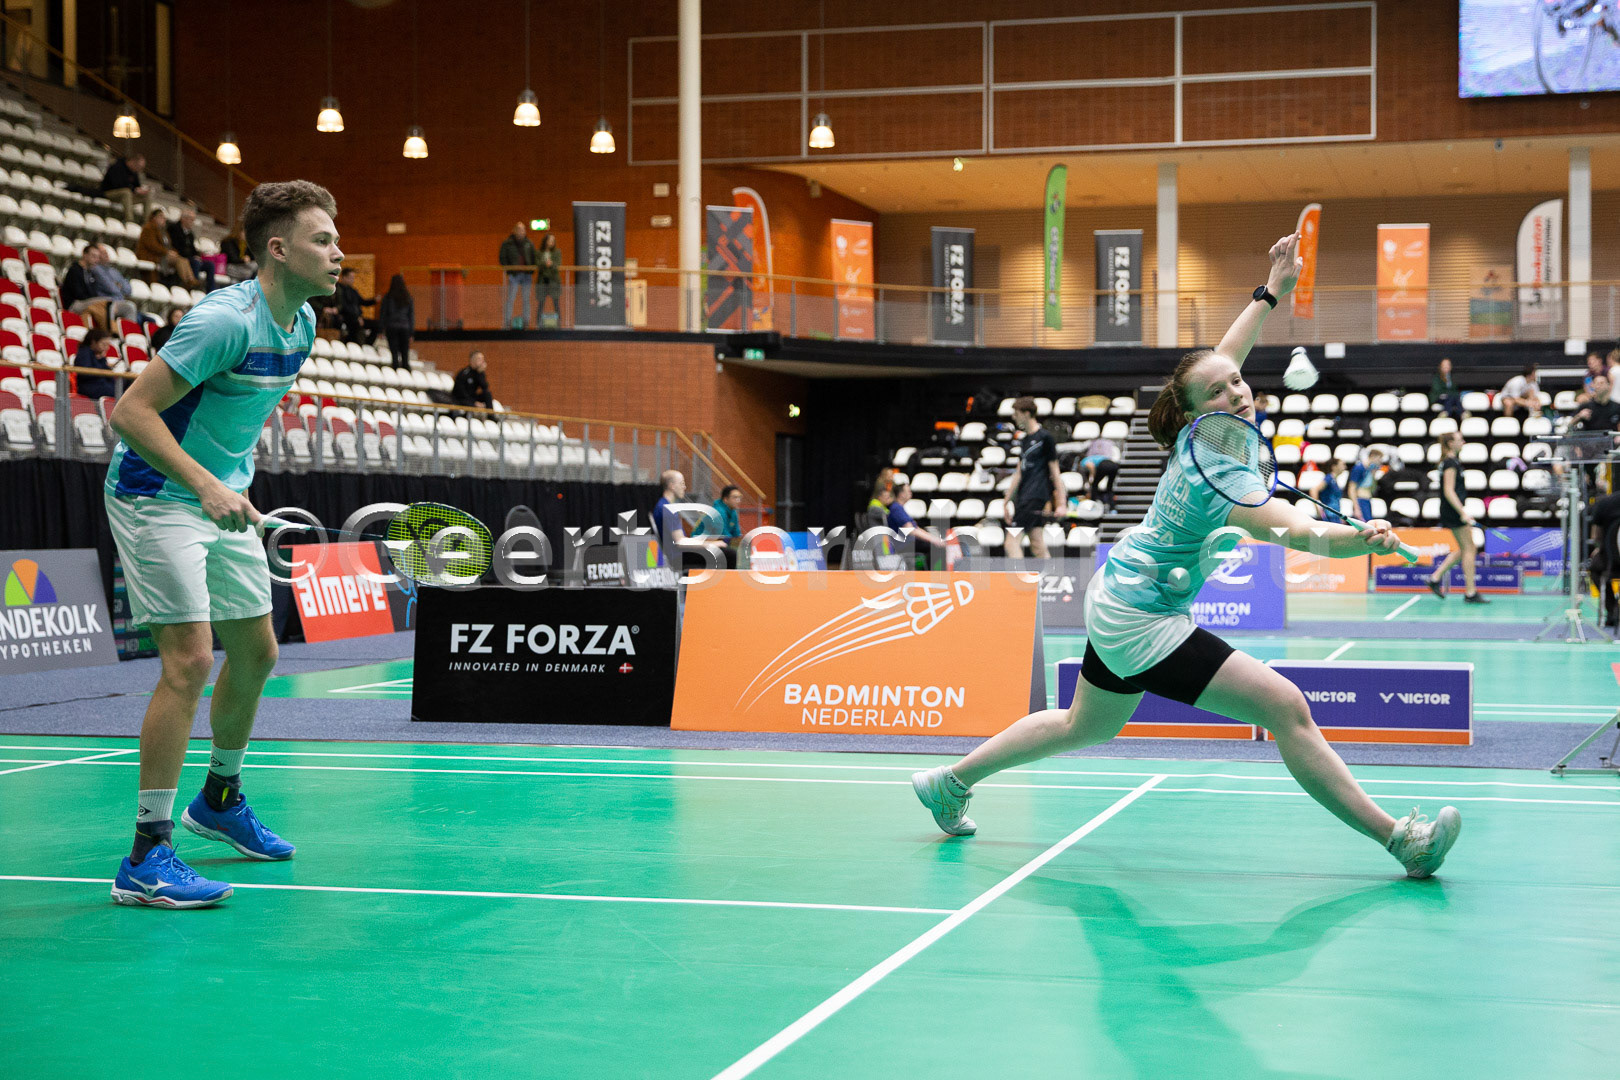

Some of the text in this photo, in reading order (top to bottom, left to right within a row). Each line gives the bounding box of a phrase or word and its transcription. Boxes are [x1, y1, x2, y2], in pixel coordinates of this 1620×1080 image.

[595, 220, 613, 308] FZ FORZA
[296, 562, 387, 618] almere
[1190, 602, 1251, 616] MINTON
[0, 603, 103, 641] NDEKOLK
[0, 638, 93, 660] YPOTHEKEN
[450, 623, 495, 654] FZ
[449, 662, 606, 673] INNOVATED IN DENMARK
[784, 683, 965, 708] BADMINTON
[1303, 690, 1357, 703] VICTOR
[1396, 692, 1451, 705] VICTOR
[801, 707, 943, 728] NEDERLAND
